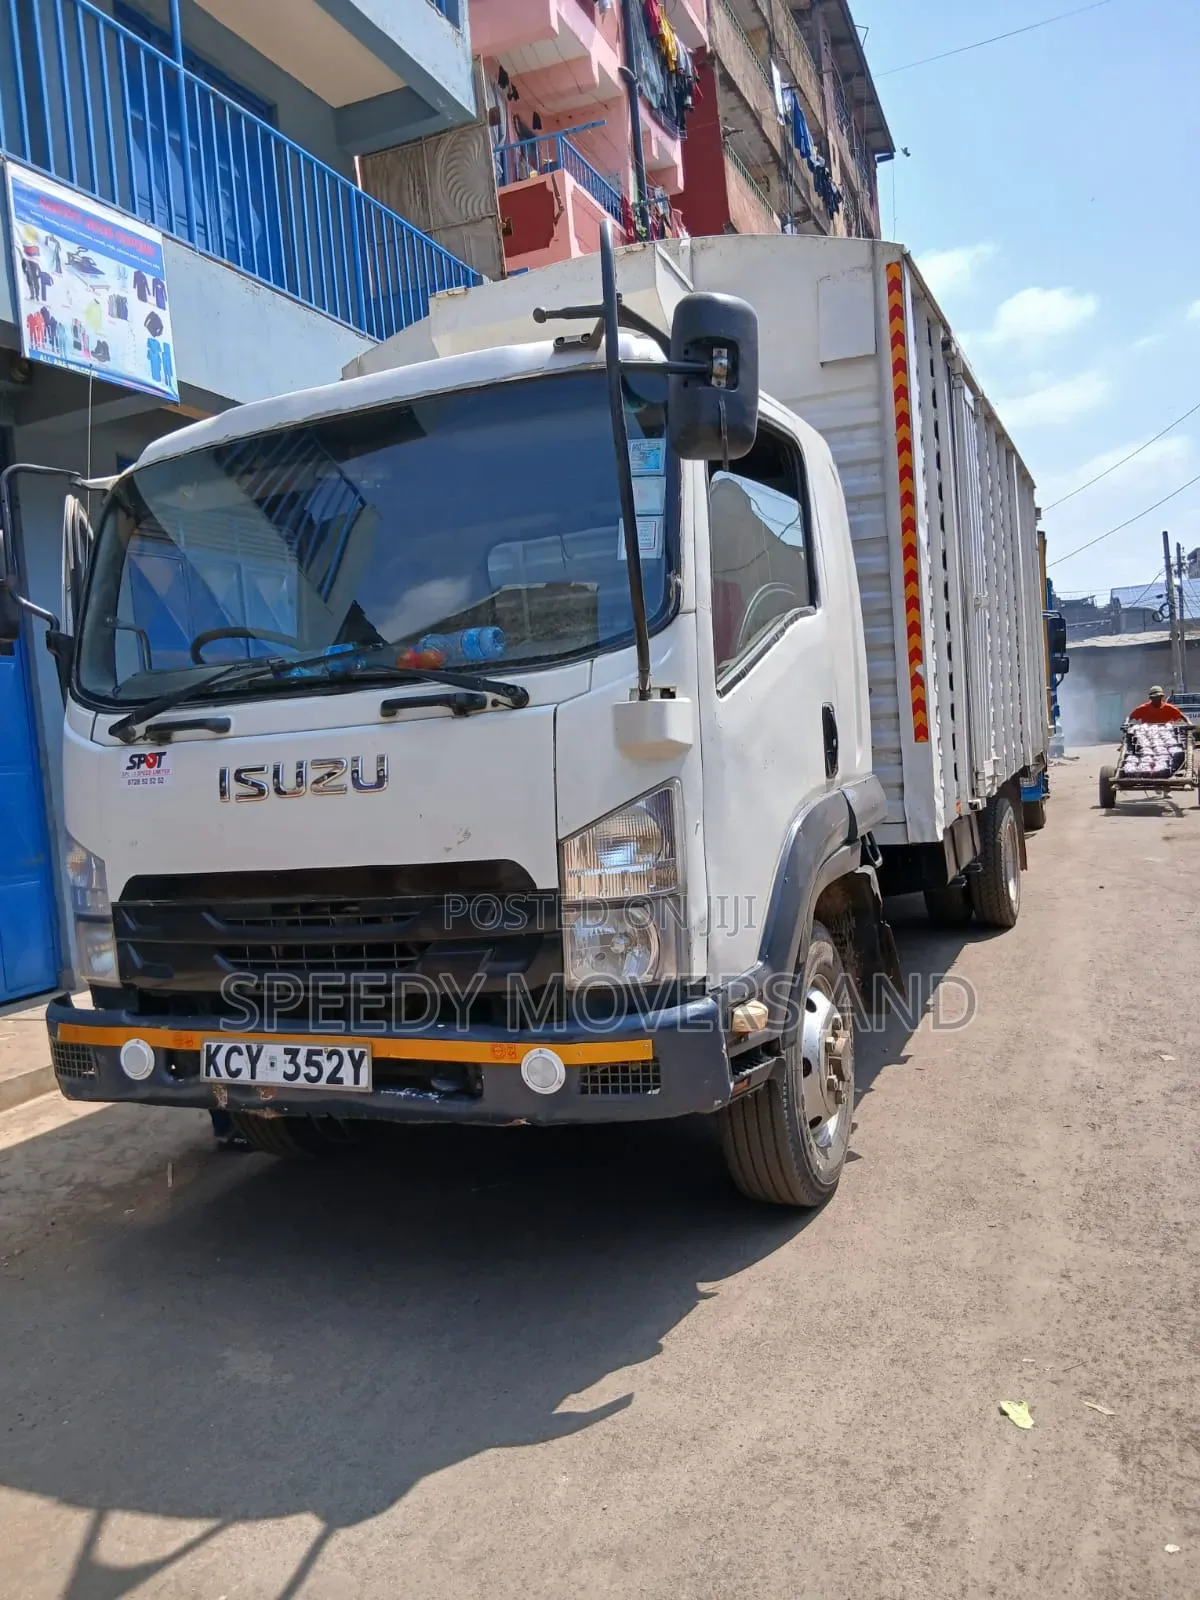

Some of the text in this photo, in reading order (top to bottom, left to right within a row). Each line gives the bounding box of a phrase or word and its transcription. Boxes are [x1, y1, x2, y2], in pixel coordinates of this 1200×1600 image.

[126, 752, 167, 770] SPOT
[219, 753, 389, 802] ISUZU
[205, 1044, 366, 1086] KCY 352Y
